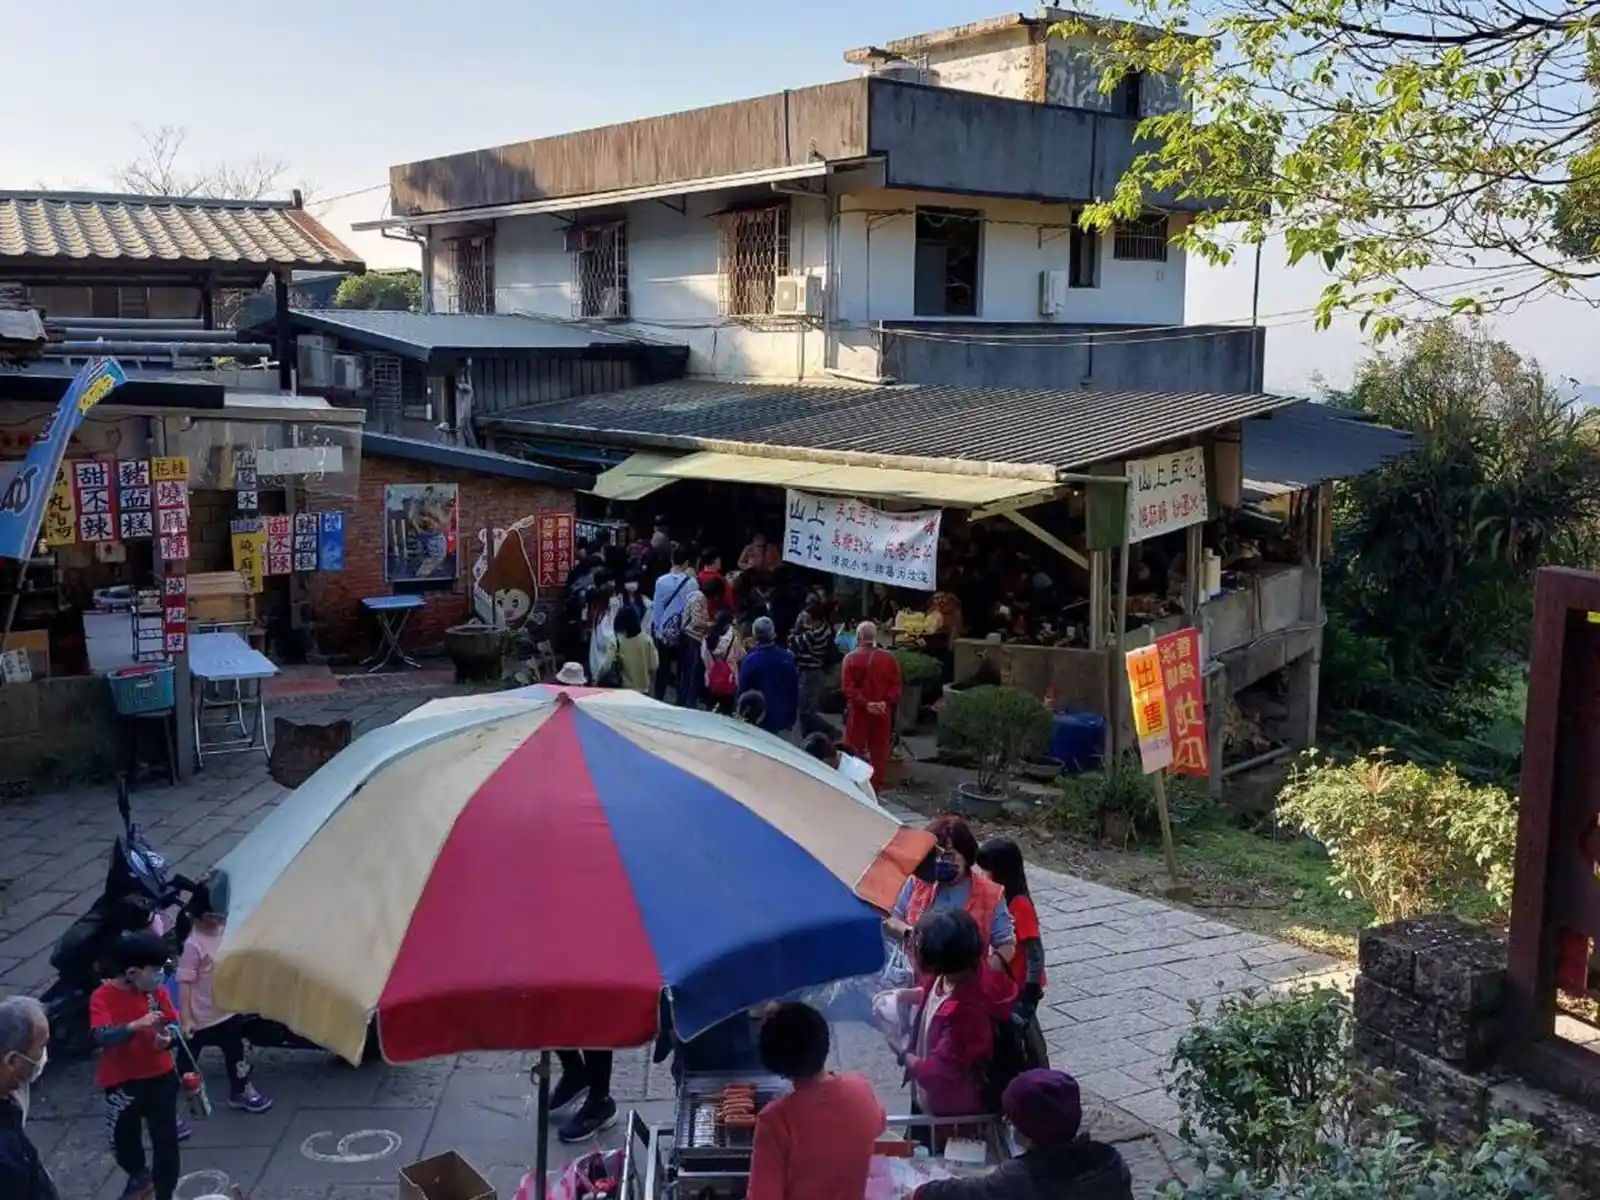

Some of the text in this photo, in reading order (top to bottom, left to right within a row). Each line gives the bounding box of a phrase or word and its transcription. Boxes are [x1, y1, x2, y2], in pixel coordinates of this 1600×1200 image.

[1138, 456, 1197, 492] 山上豆花
[79, 465, 110, 539] 甜不辣
[120, 461, 152, 536] 豬血糕
[789, 498, 826, 527] 山上
[268, 516, 292, 573] 甜不辣
[787, 529, 823, 562] 豆花
